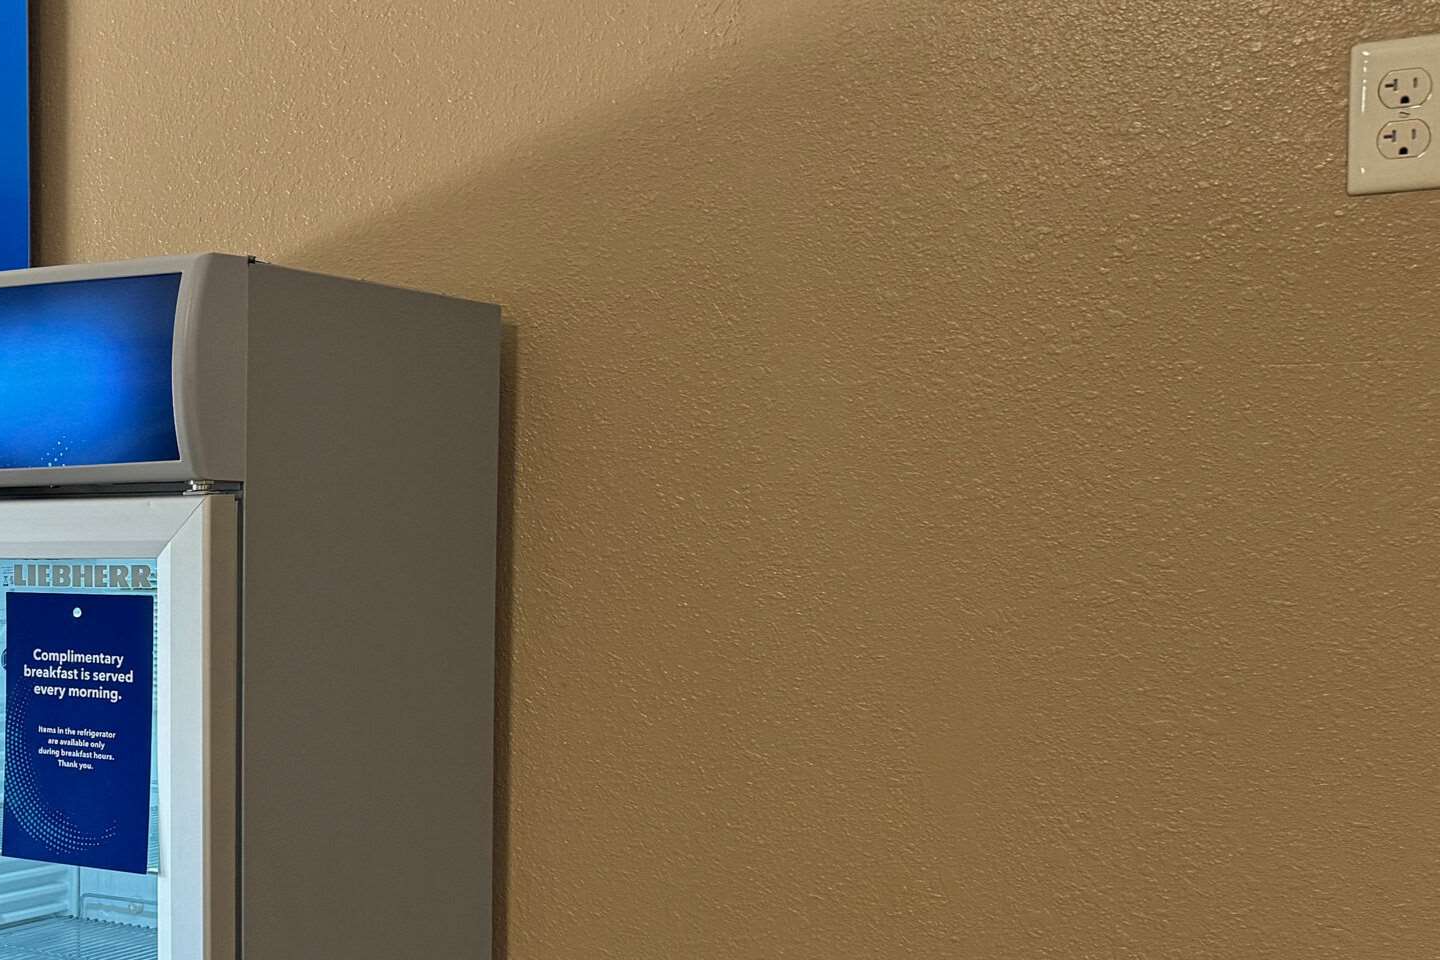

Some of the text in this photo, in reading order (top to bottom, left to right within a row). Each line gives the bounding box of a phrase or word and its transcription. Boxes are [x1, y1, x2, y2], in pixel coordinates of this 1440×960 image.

[13, 564, 152, 588] LIEBHERR
[33, 648, 124, 668] Complimentary
[23, 664, 134, 683] breakfast is served
[33, 685, 122, 703] every morning.
[38, 725, 116, 739] Items in the refrigerator
[59, 738, 89, 748] available
[90, 740, 106, 751] only
[38, 746, 115, 761] during breakfast hours.
[57, 759, 94, 771] Thank you.
